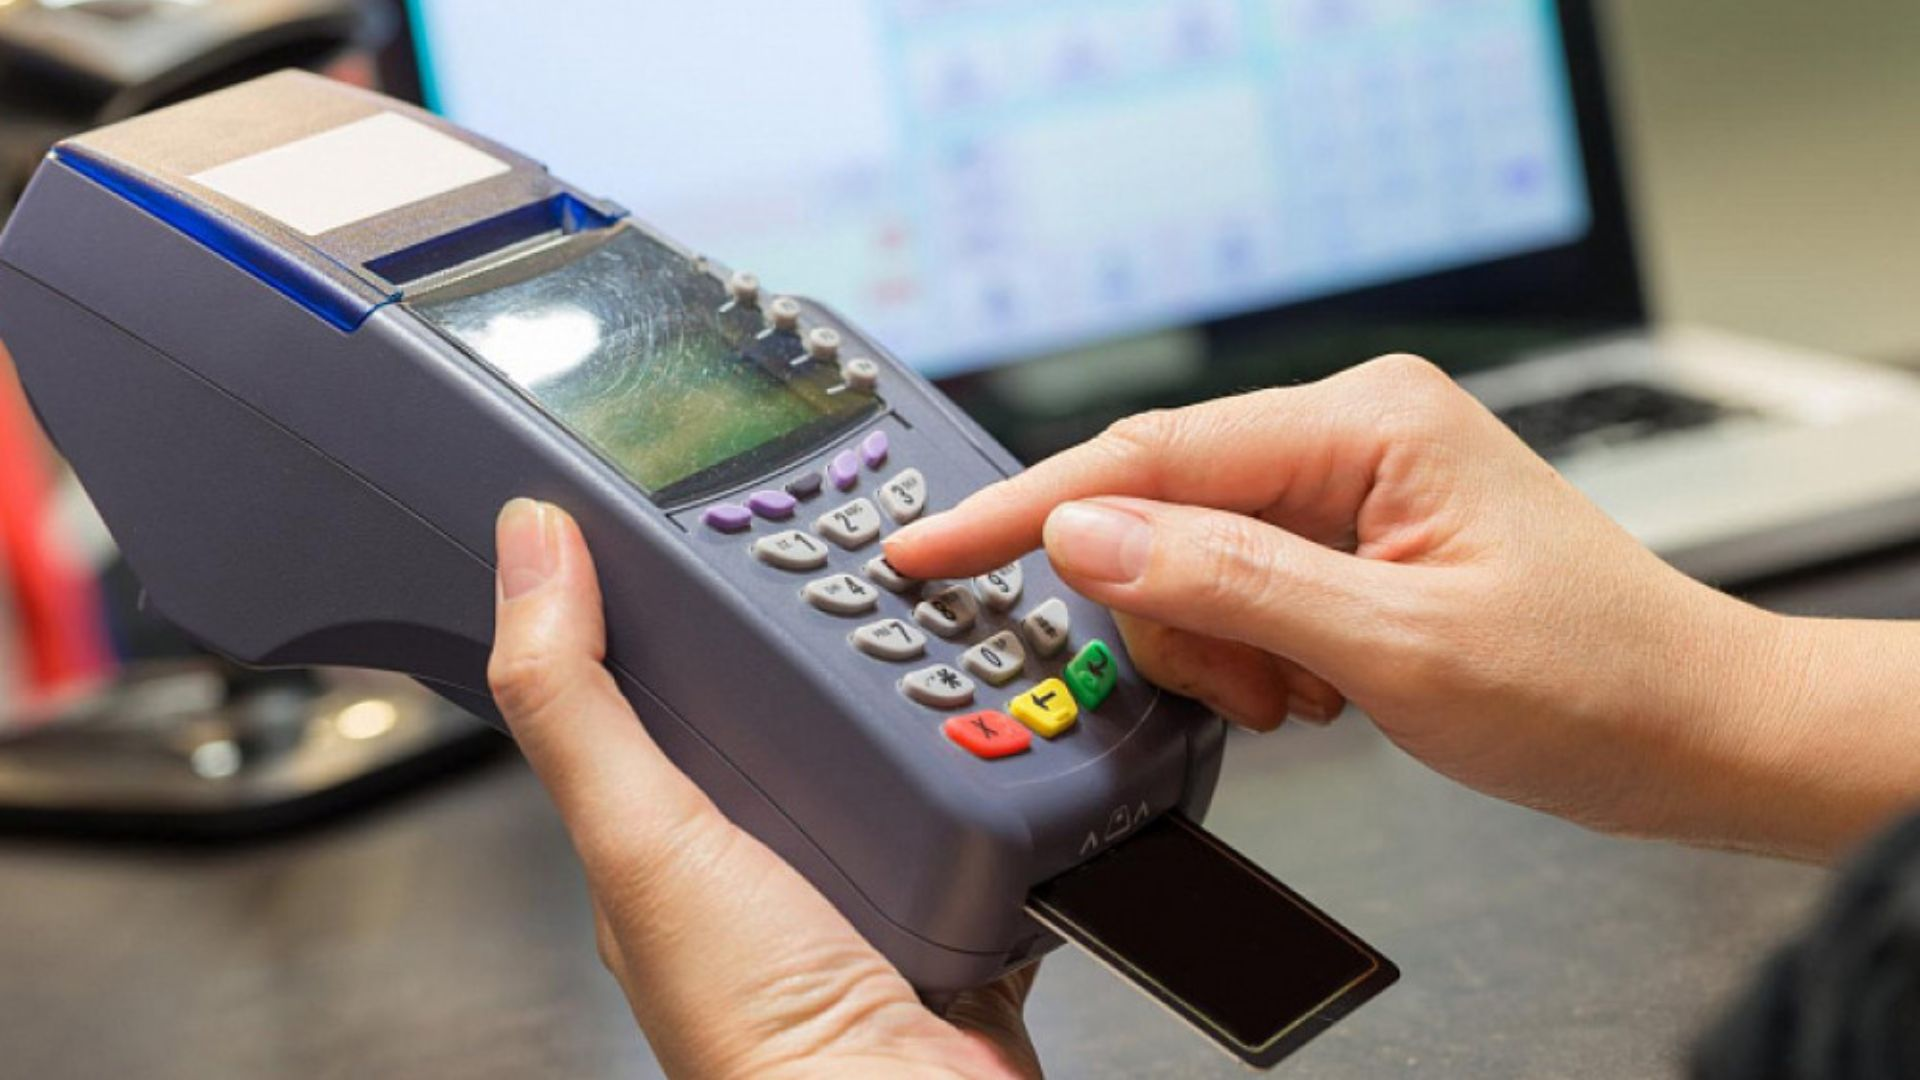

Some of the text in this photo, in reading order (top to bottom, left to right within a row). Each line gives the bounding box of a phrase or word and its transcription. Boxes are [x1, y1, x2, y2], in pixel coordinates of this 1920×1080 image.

[891, 484, 915, 505] 3
[833, 511, 859, 533] 2
[793, 532, 816, 551] 1
[844, 576, 866, 595] 4
[933, 600, 957, 621] 8
[890, 620, 912, 643] 7
[980, 646, 1003, 668] 0
